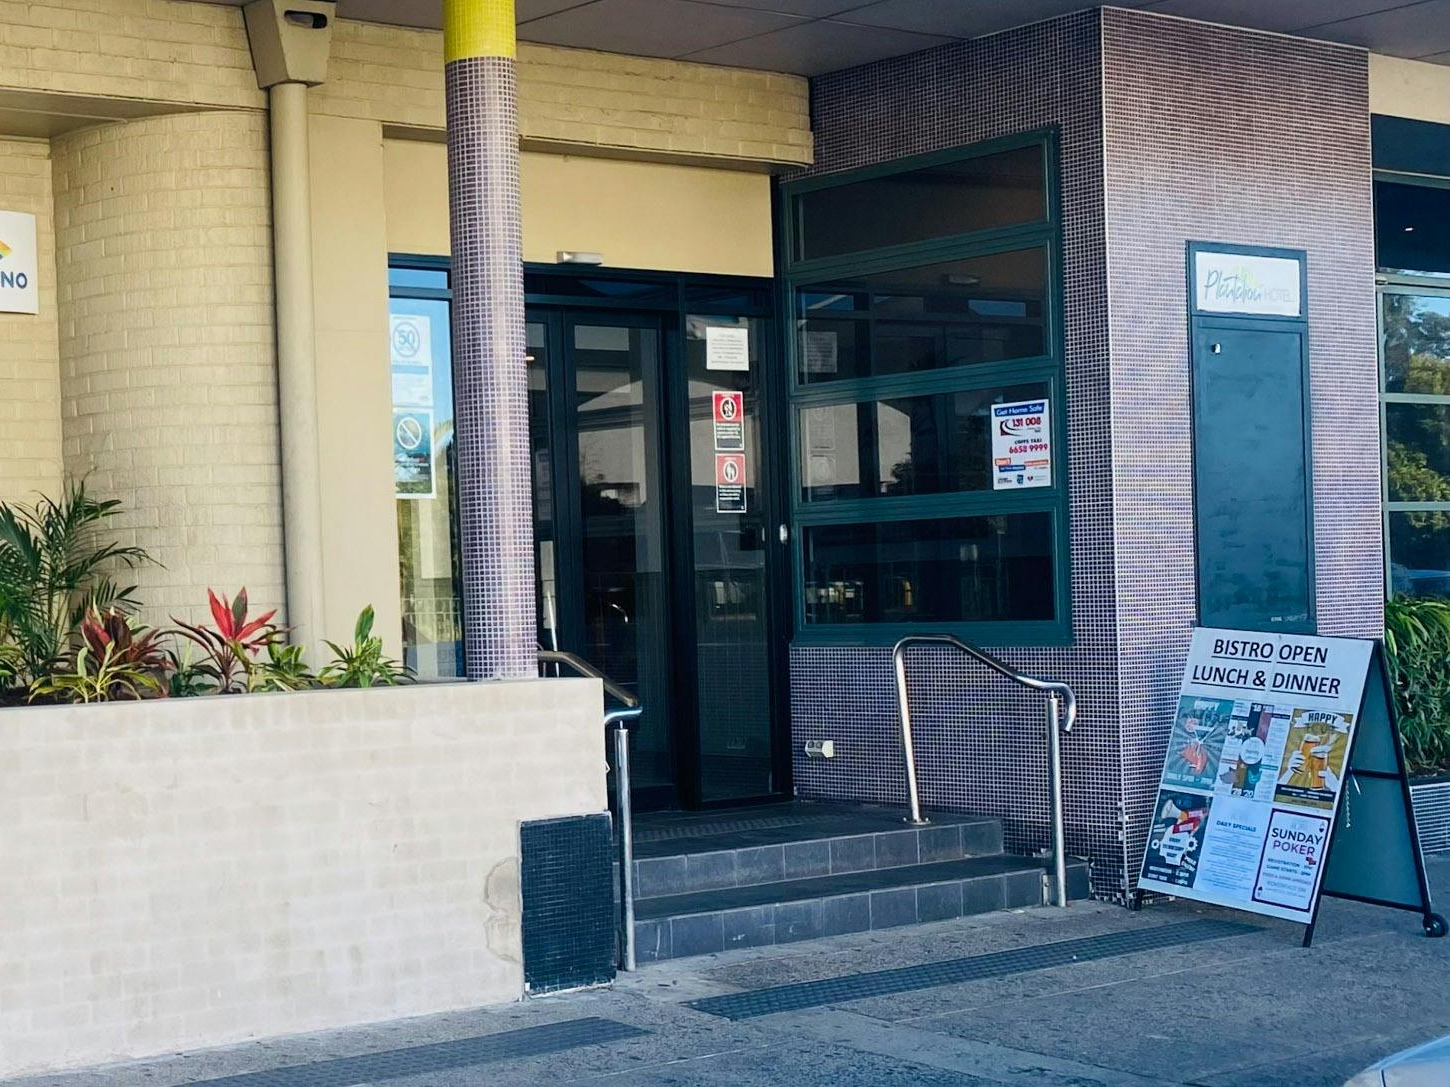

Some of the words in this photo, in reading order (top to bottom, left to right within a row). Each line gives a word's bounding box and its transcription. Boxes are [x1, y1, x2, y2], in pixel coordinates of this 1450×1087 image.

[996, 408, 1008, 416] Get
[1009, 406, 1028, 414] Home
[1029, 404, 1043, 413] Safe
[1030, 443, 1048, 452] 9999
[1213, 639, 1274, 659] BISTRO
[1278, 644, 1329, 664] OPEN
[1192, 665, 1249, 685] LUNCH
[1253, 670, 1266, 687] &
[1272, 672, 1341, 695] DINNER
[1308, 712, 1338, 724] HAPPY
[1271, 827, 1323, 845] SUNDAY
[1273, 839, 1316, 856] POKER
